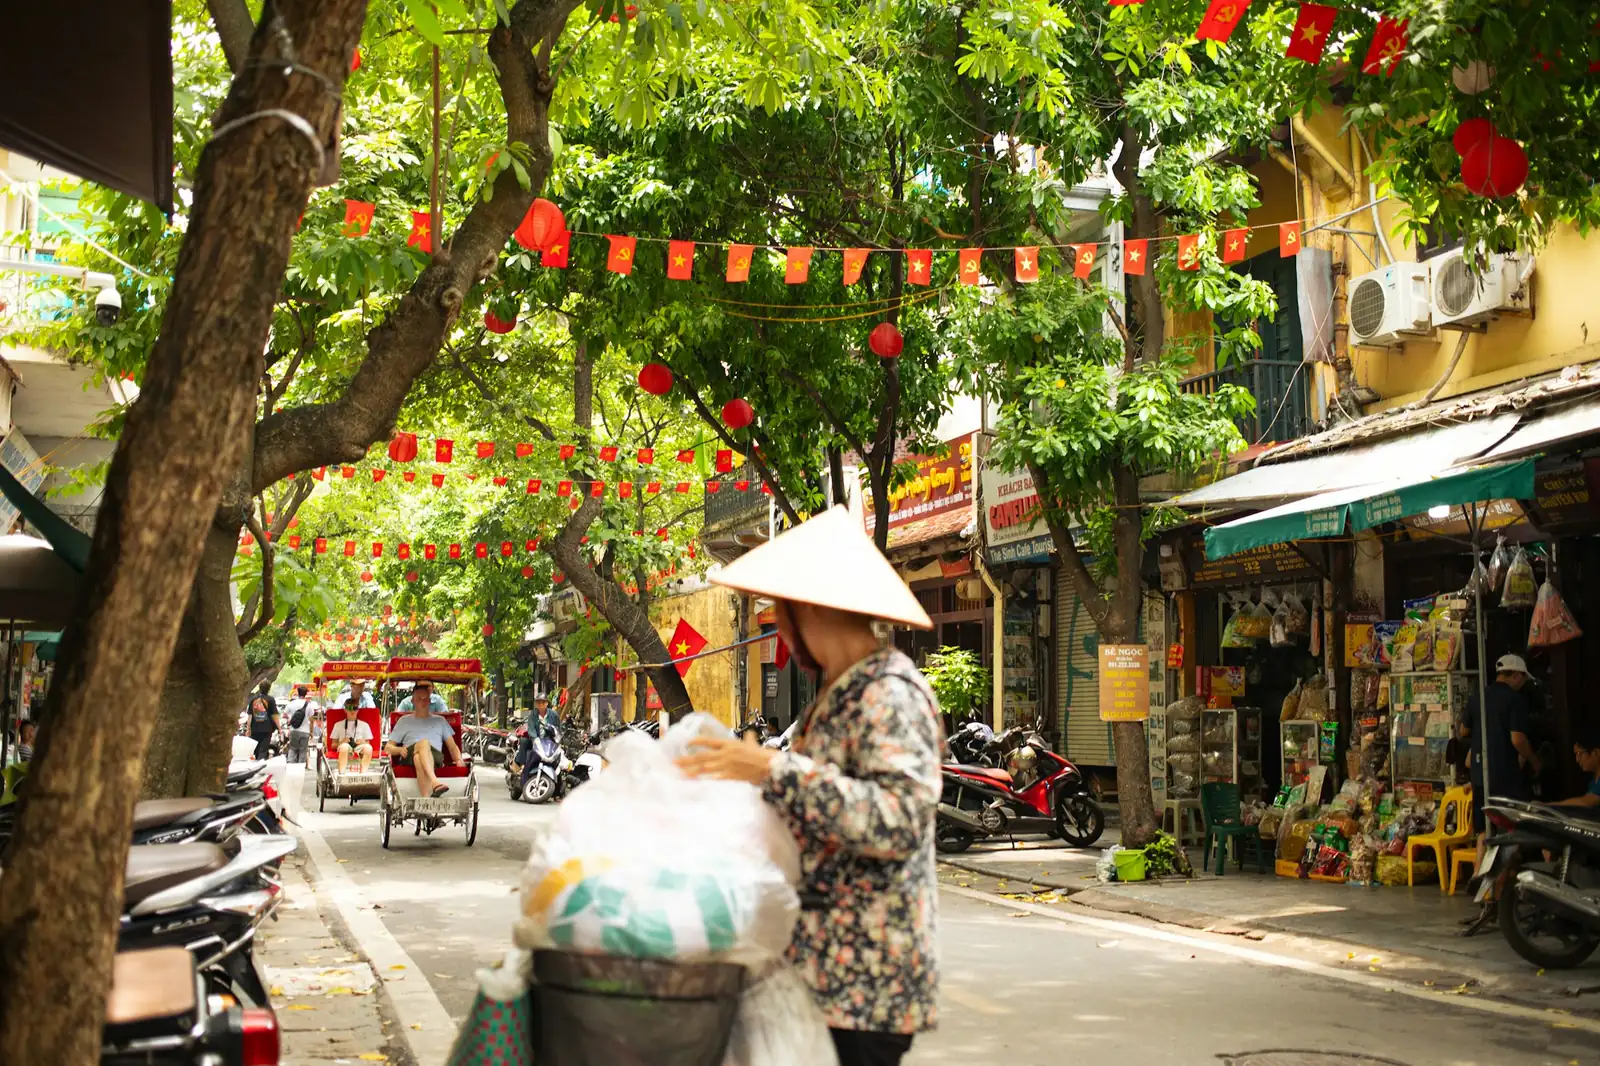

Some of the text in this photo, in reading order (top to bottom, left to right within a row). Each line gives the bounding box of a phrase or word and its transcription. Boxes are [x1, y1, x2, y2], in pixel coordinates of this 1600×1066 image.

[990, 549, 1003, 562] The
[1016, 542, 1031, 557] Cafe
[1244, 561, 1260, 571] 32
